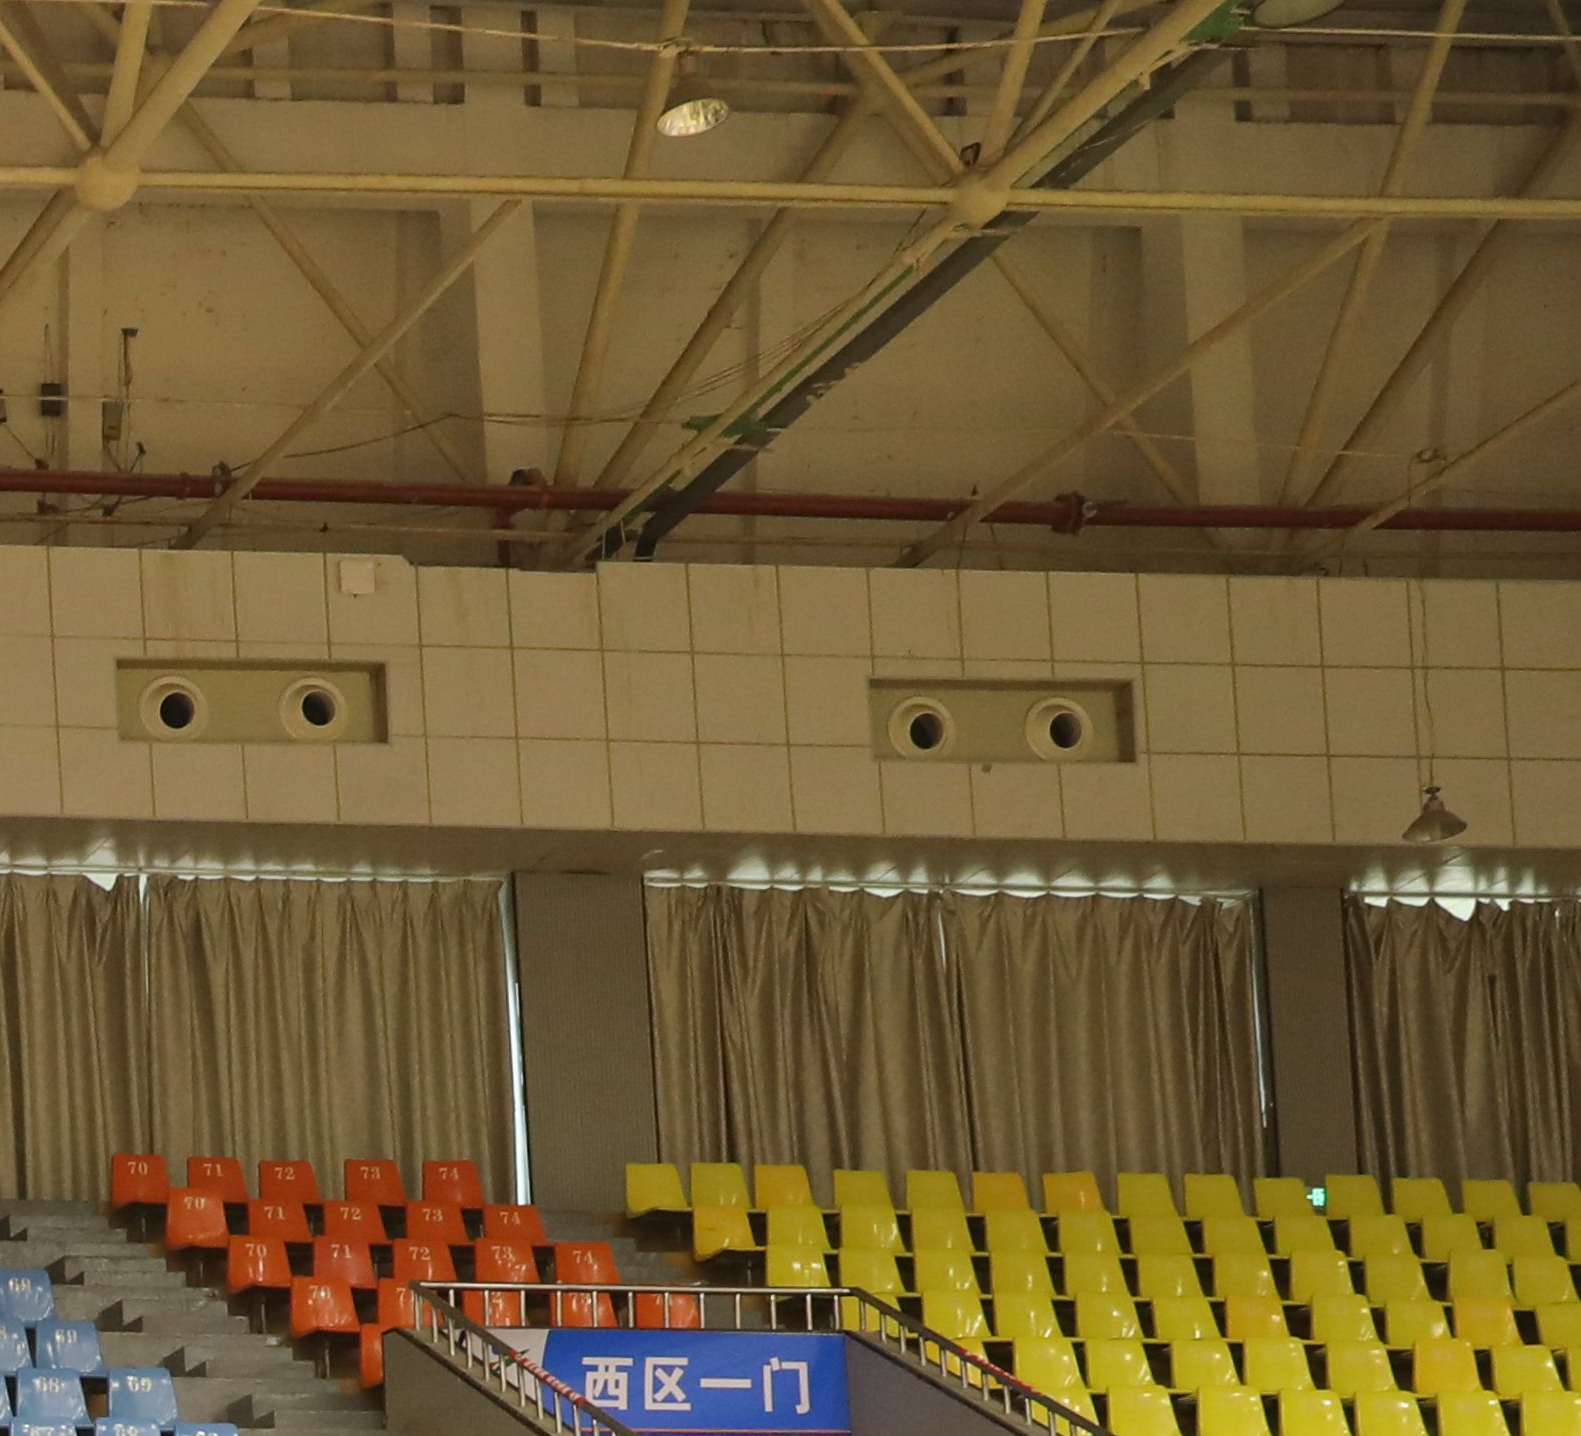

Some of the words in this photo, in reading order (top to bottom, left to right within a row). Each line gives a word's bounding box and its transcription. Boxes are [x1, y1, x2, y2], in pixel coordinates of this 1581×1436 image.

[128, 1162, 147, 1175] 70
[203, 1163, 223, 1177] 71
[275, 1166, 295, 1180] 72
[360, 1166, 381, 1180] 73
[439, 1167, 459, 1180] 74
[264, 1206, 285, 1219] 71
[340, 1207, 361, 1220] 72
[422, 1209, 443, 1222] 73
[500, 1211, 521, 1225] 74
[331, 1244, 351, 1258] 71
[410, 1247, 430, 1260] 72
[573, 1250, 593, 1264] 74
[582, 1357, 810, 1415] 西区一门
